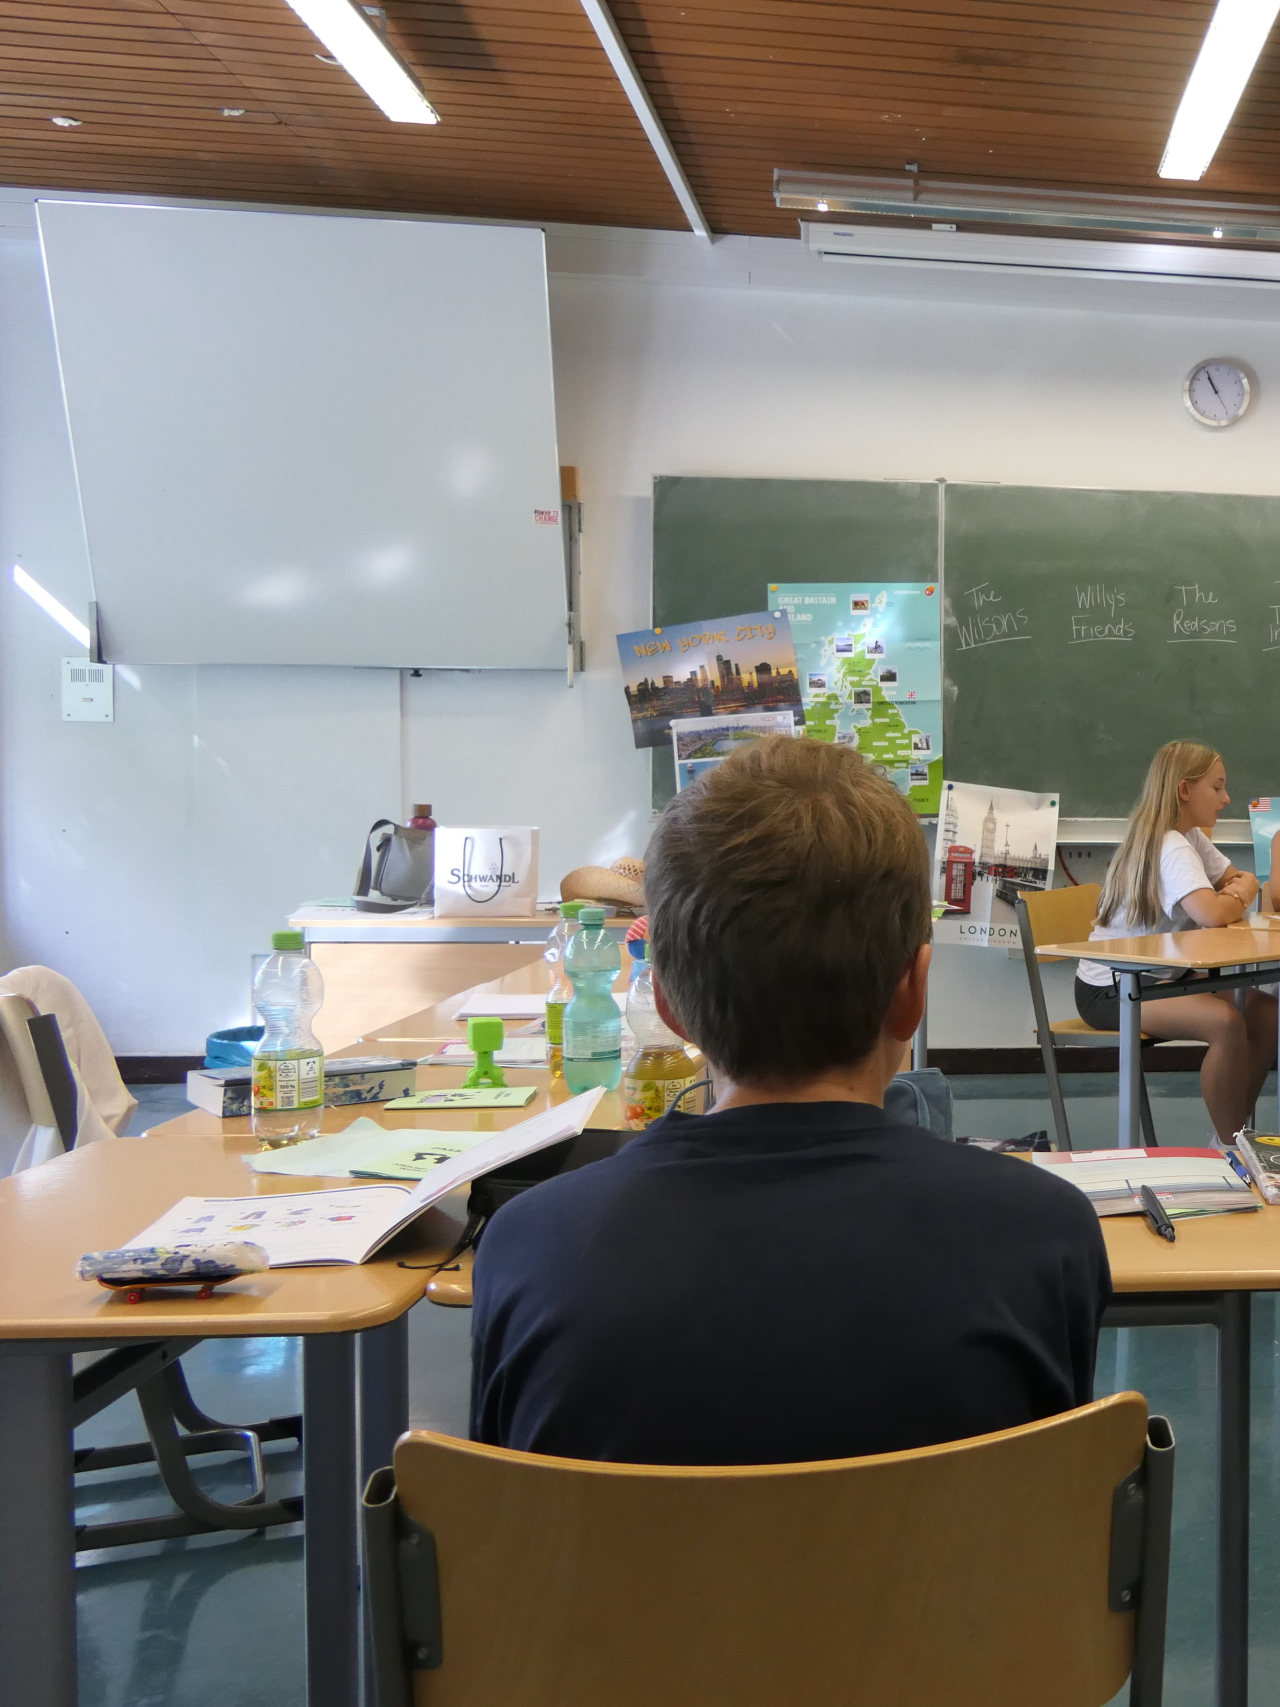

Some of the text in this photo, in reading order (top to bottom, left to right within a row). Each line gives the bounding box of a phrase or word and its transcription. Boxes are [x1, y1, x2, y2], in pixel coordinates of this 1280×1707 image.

[778, 596, 836, 604] GREAT BRITAIN
[964, 582, 1002, 610] The
[1075, 583, 1126, 617] Willy's
[1174, 583, 1218, 606] The
[788, 614, 812, 622] ELAND
[1071, 615, 1136, 639] Friends
[956, 608, 1029, 649] Wilsons
[633, 640, 672, 658] NEW
[447, 868, 520, 884] SCHWANDL
[960, 925, 1018, 938] LONDON
